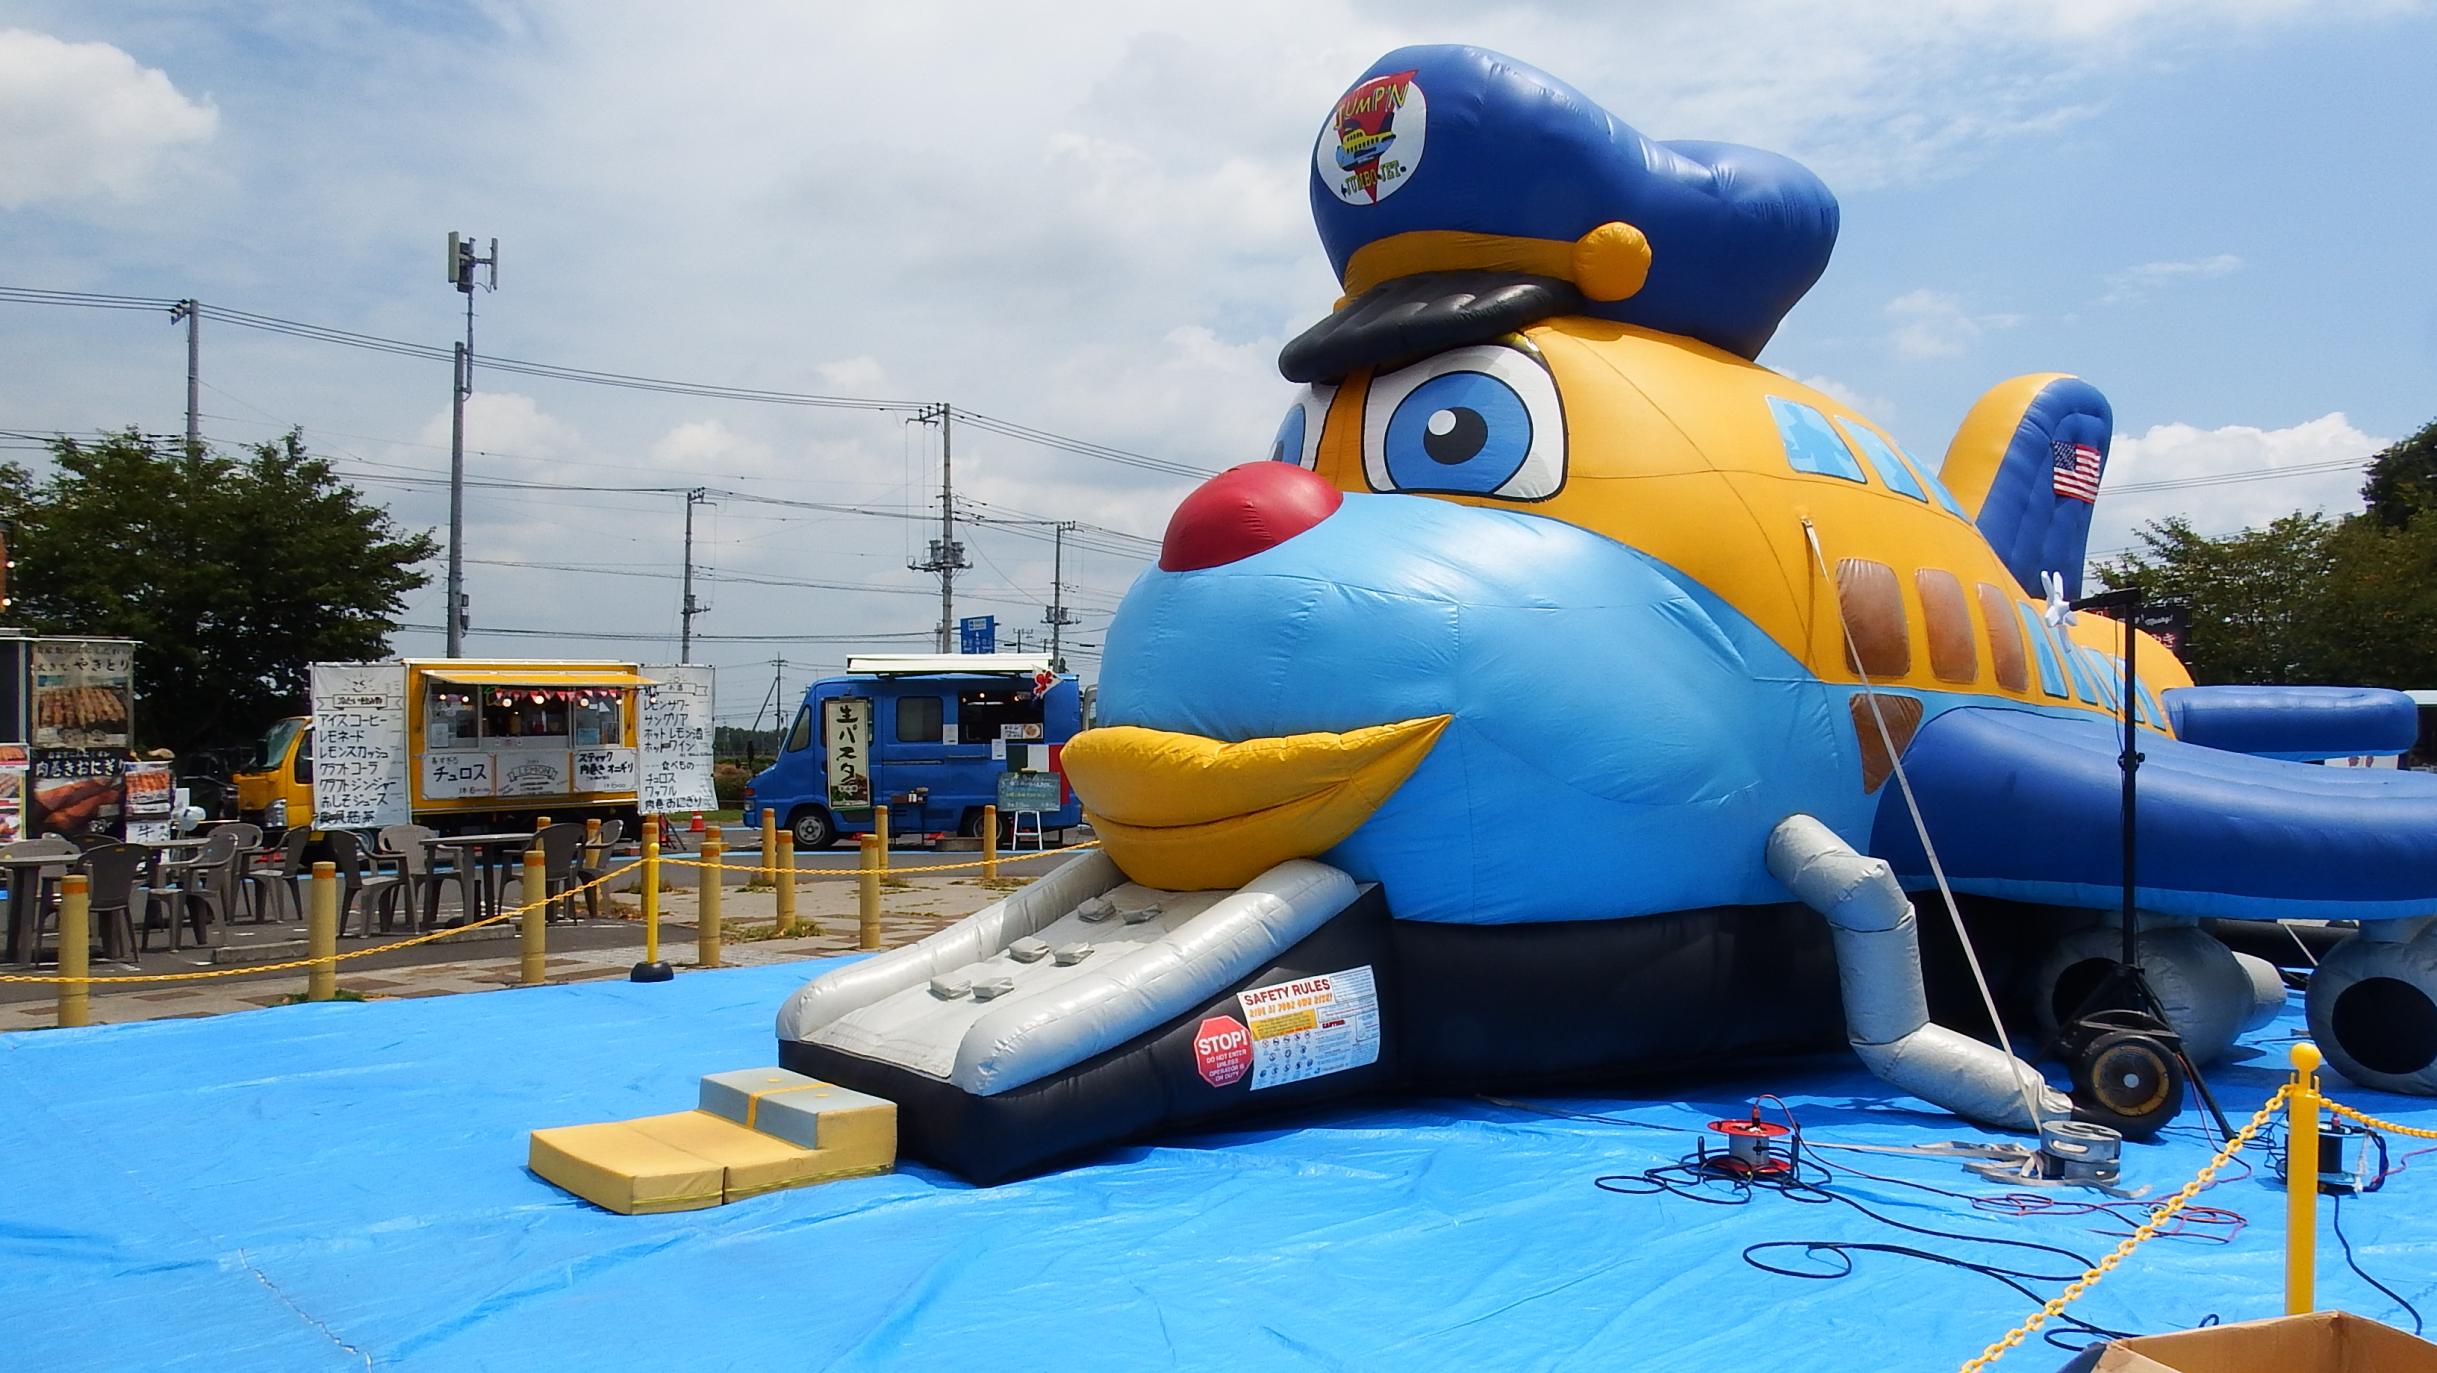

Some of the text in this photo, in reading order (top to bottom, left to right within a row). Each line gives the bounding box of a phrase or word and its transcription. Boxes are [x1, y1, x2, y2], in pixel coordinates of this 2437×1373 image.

[318, 713, 388, 727] アイスコーヒー
[644, 713, 689, 727] サングリア
[319, 730, 365, 743] レモネード
[836, 704, 858, 783] 生パスタ
[319, 746, 389, 759] レモンスカッシュ
[319, 762, 379, 776] クラフトコーラ
[433, 764, 487, 782] チュロス
[1244, 987, 1289, 1006] SAFETY
[1293, 979, 1330, 997] RULES
[1199, 1030, 1248, 1055] STOP!
[1216, 1053, 1228, 1061] NOT
